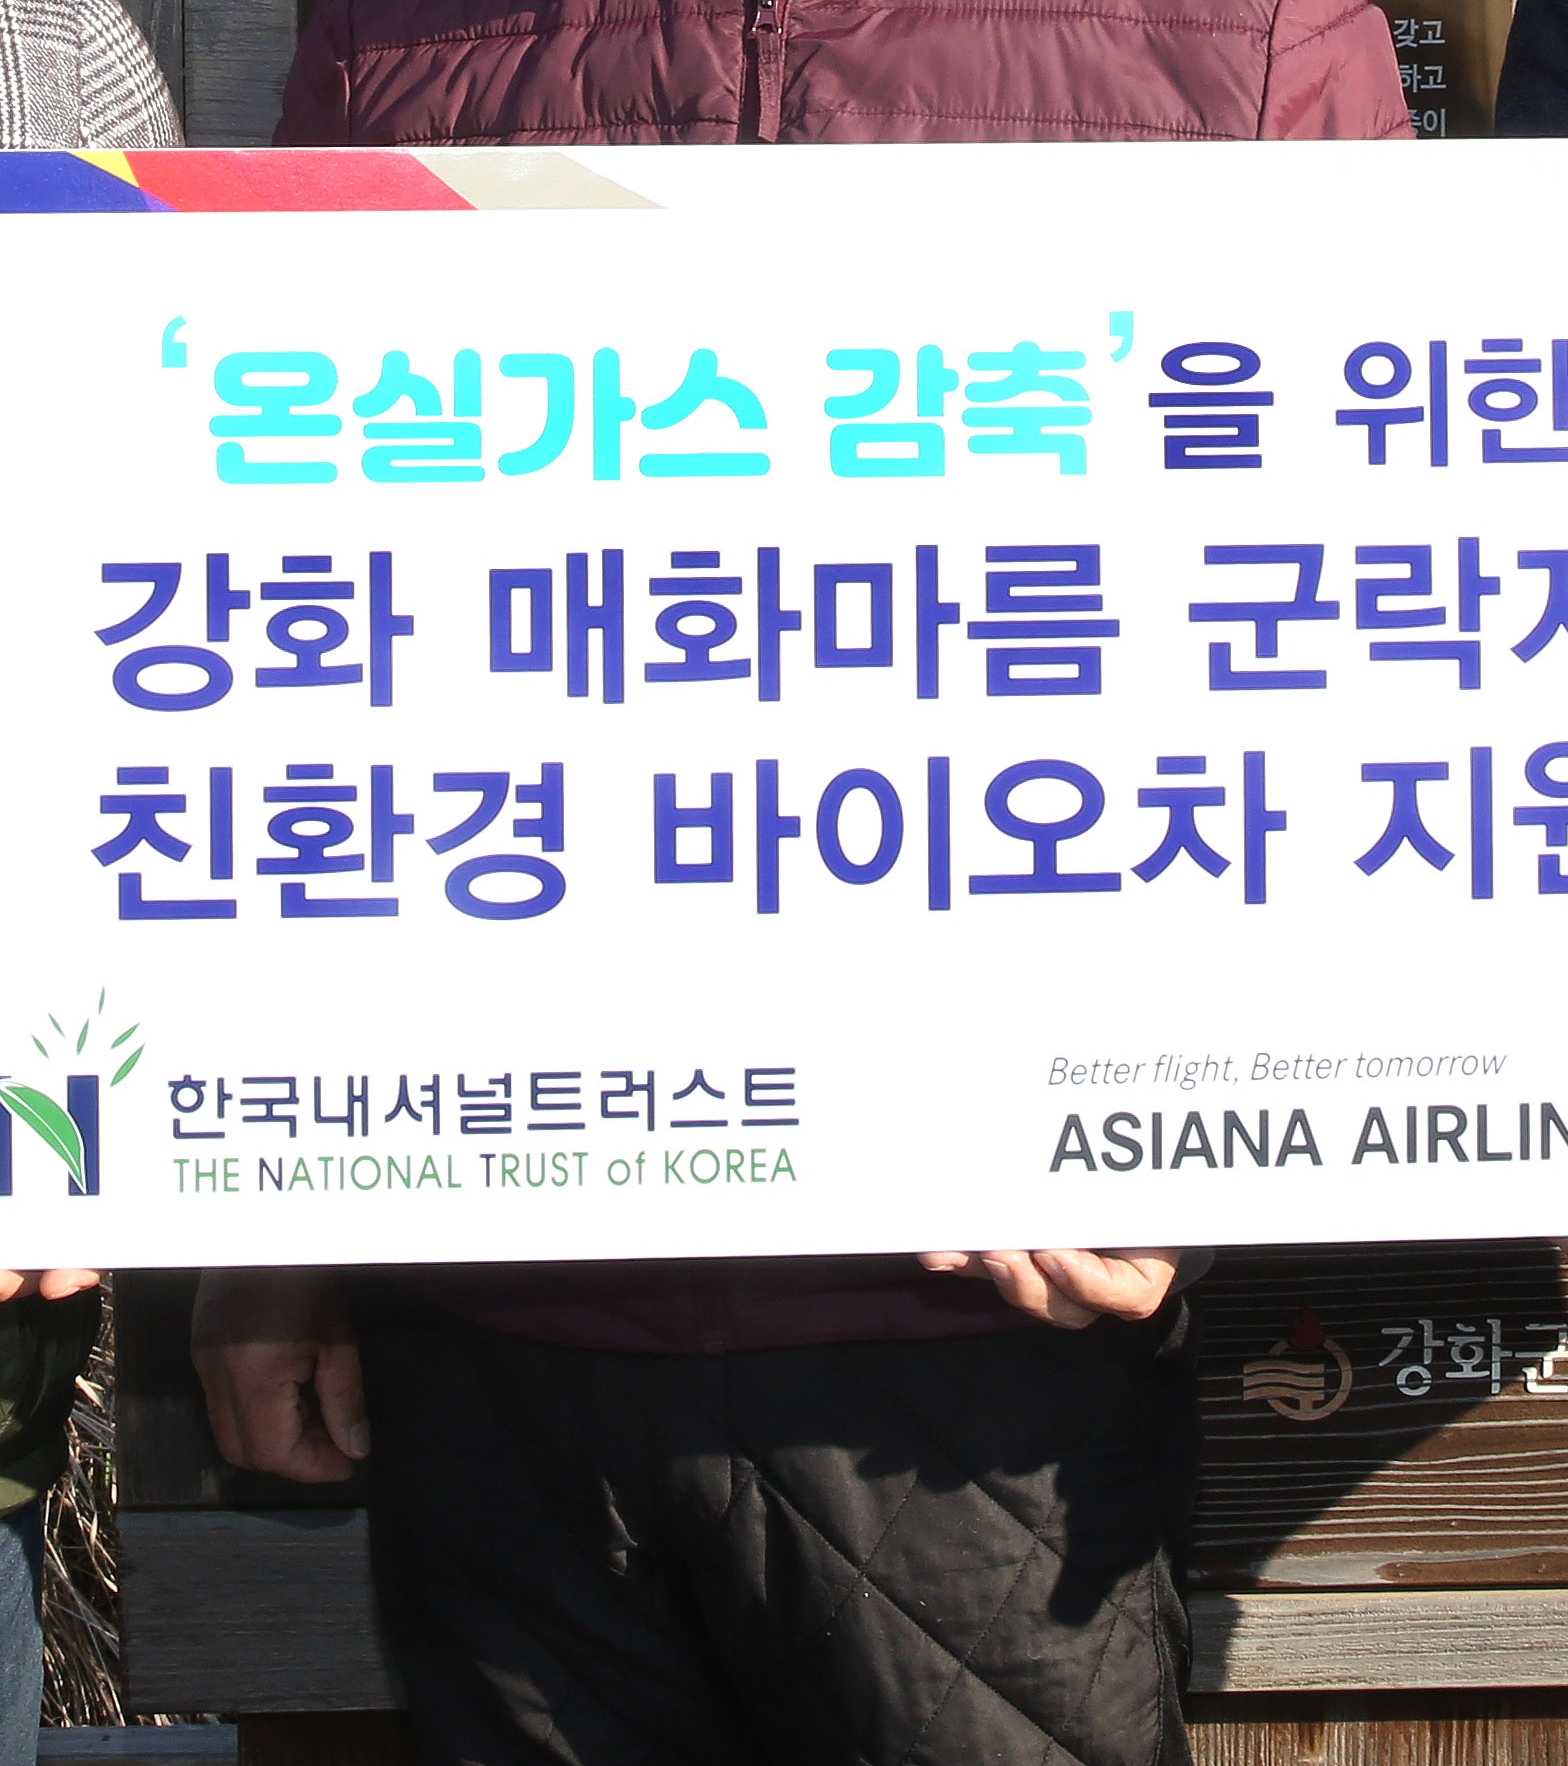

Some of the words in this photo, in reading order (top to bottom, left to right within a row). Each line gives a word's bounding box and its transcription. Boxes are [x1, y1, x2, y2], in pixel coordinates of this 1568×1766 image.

[1393, 18, 1446, 48] 갖고
[93, 548, 415, 713] 강화
[488, 542, 1121, 704] 매화마름
[89, 760, 567, 922] 친환경
[653, 748, 1288, 915] 바이오차
[1049, 1057, 1146, 1087] Better
[1153, 1053, 1240, 1091] flight,
[1251, 1052, 1347, 1082] Better
[1356, 1050, 1508, 1079] tomorrow
[167, 1067, 801, 1140] 한국내셔널트러스트
[174, 1157, 240, 1194] THE
[259, 1154, 463, 1193] NATIONAL
[480, 1152, 589, 1189] TRUST
[608, 1150, 646, 1186] of
[663, 1148, 797, 1186] KOREA
[1048, 1108, 1323, 1173] ASIANA
